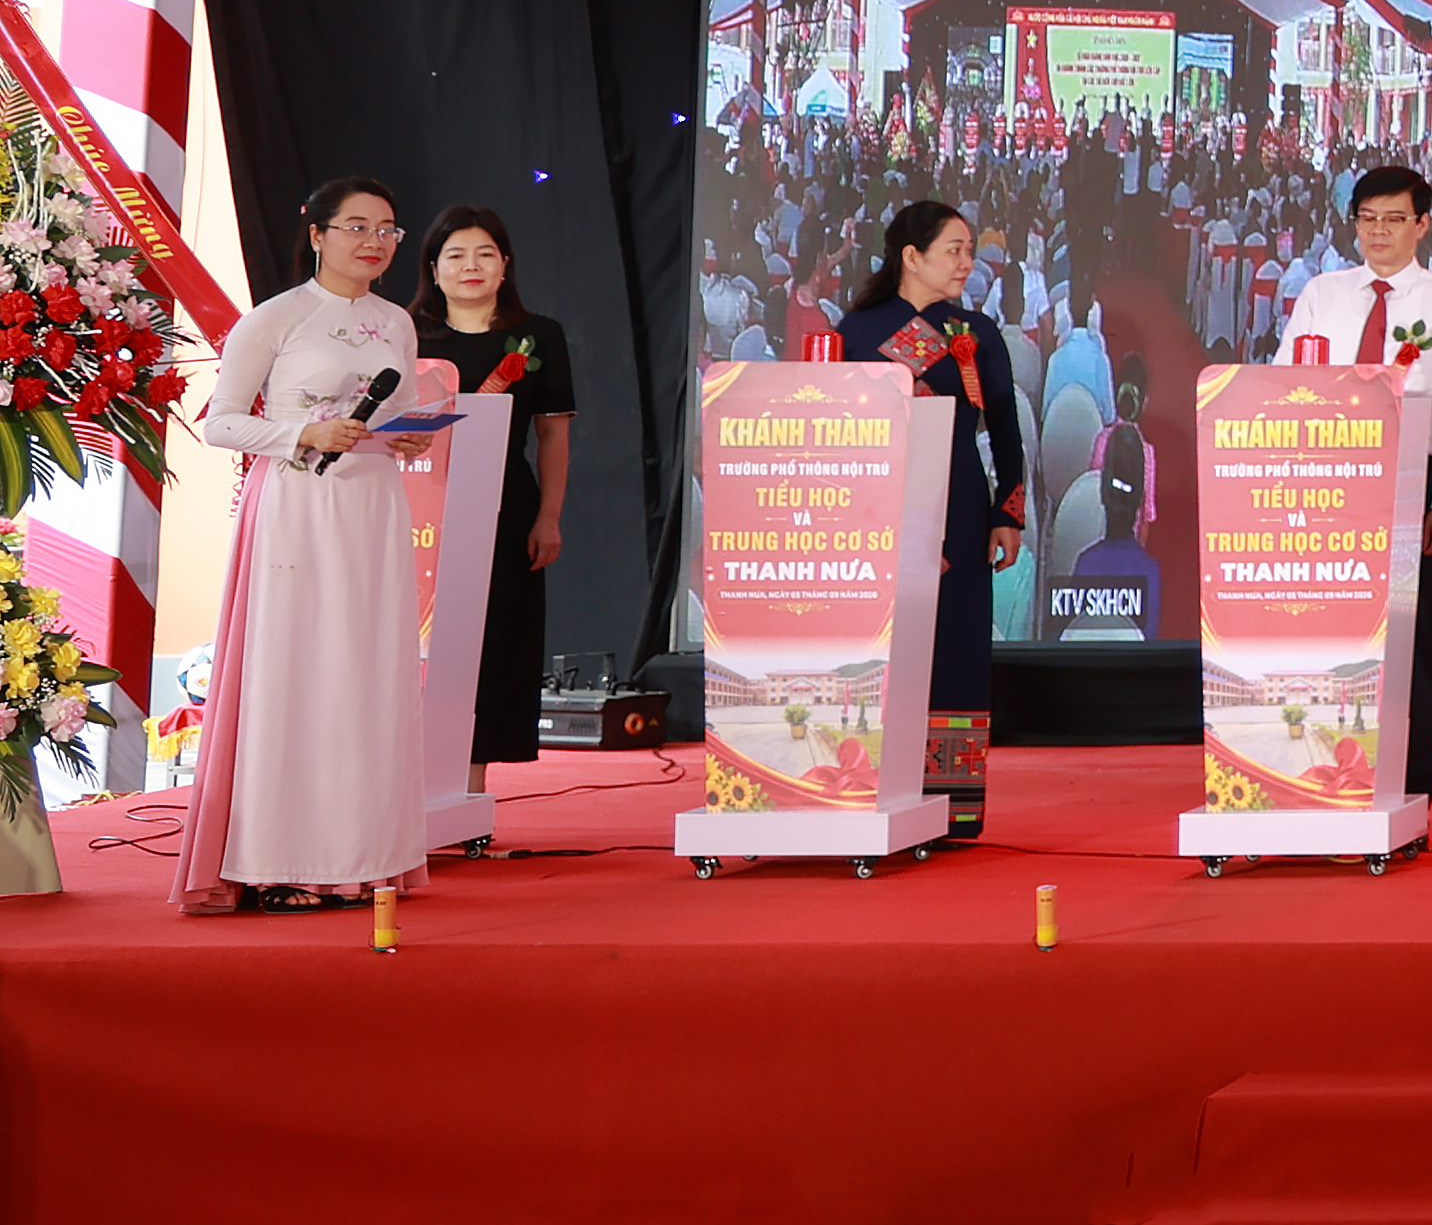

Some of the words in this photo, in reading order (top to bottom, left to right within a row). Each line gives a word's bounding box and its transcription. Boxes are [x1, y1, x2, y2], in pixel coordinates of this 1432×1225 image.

[719, 411, 806, 447] KHÁNH
[810, 412, 892, 447] THÀNH
[1214, 413, 1299, 448] KHÁNH
[1304, 413, 1384, 448] THÀNH
[723, 561, 815, 582] THANH
[820, 558, 877, 581] NƯA
[1220, 562, 1310, 582] THANH
[1315, 558, 1371, 582] NƯA
[1051, 588, 1085, 616] KTV
[1086, 588, 1142, 617] SKHCN
